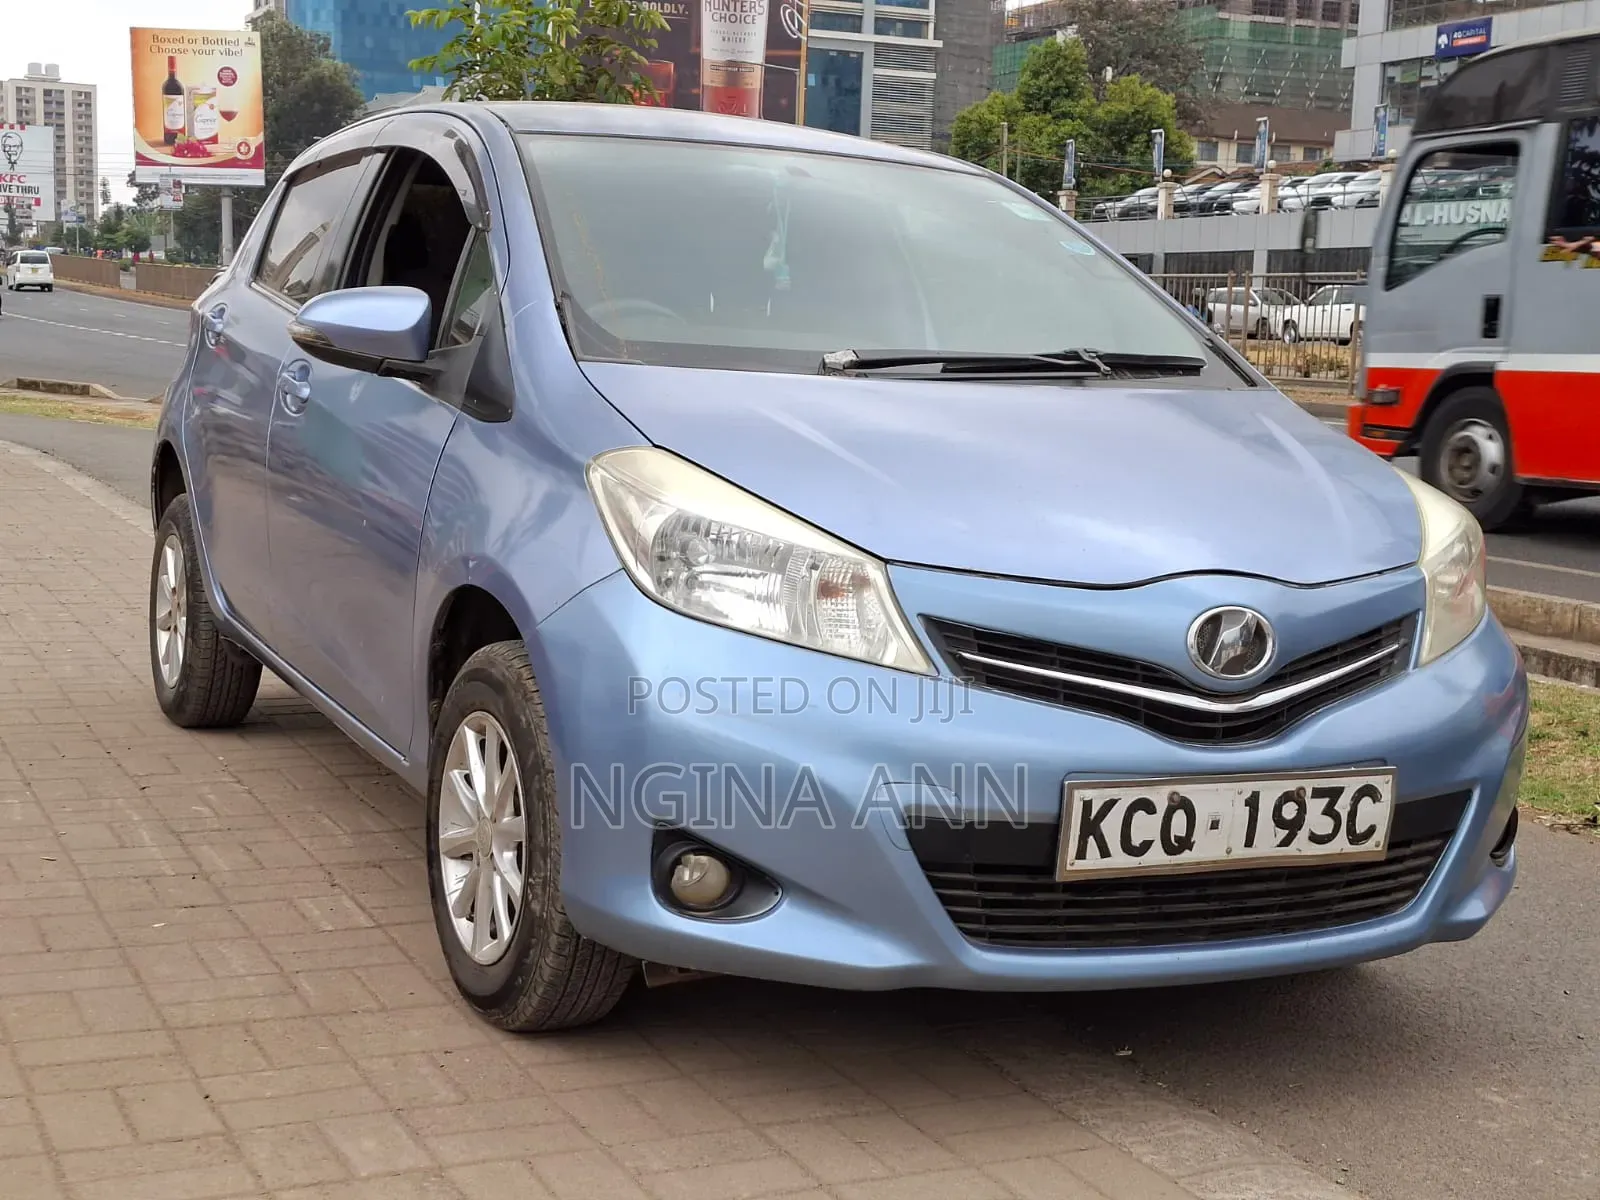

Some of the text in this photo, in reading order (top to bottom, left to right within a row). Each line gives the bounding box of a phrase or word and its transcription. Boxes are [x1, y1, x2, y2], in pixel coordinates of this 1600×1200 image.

[711, 12, 757, 25] CHOICE
[152, 34, 185, 44] Boxed
[187, 37, 198, 45] or
[202, 36, 240, 47] Bottled
[149, 45, 243, 57] Choose your vibe!
[0, 173, 27, 184] KFC
[16, 185, 40, 195] THRU
[1075, 784, 1383, 860] KCQ 193C
